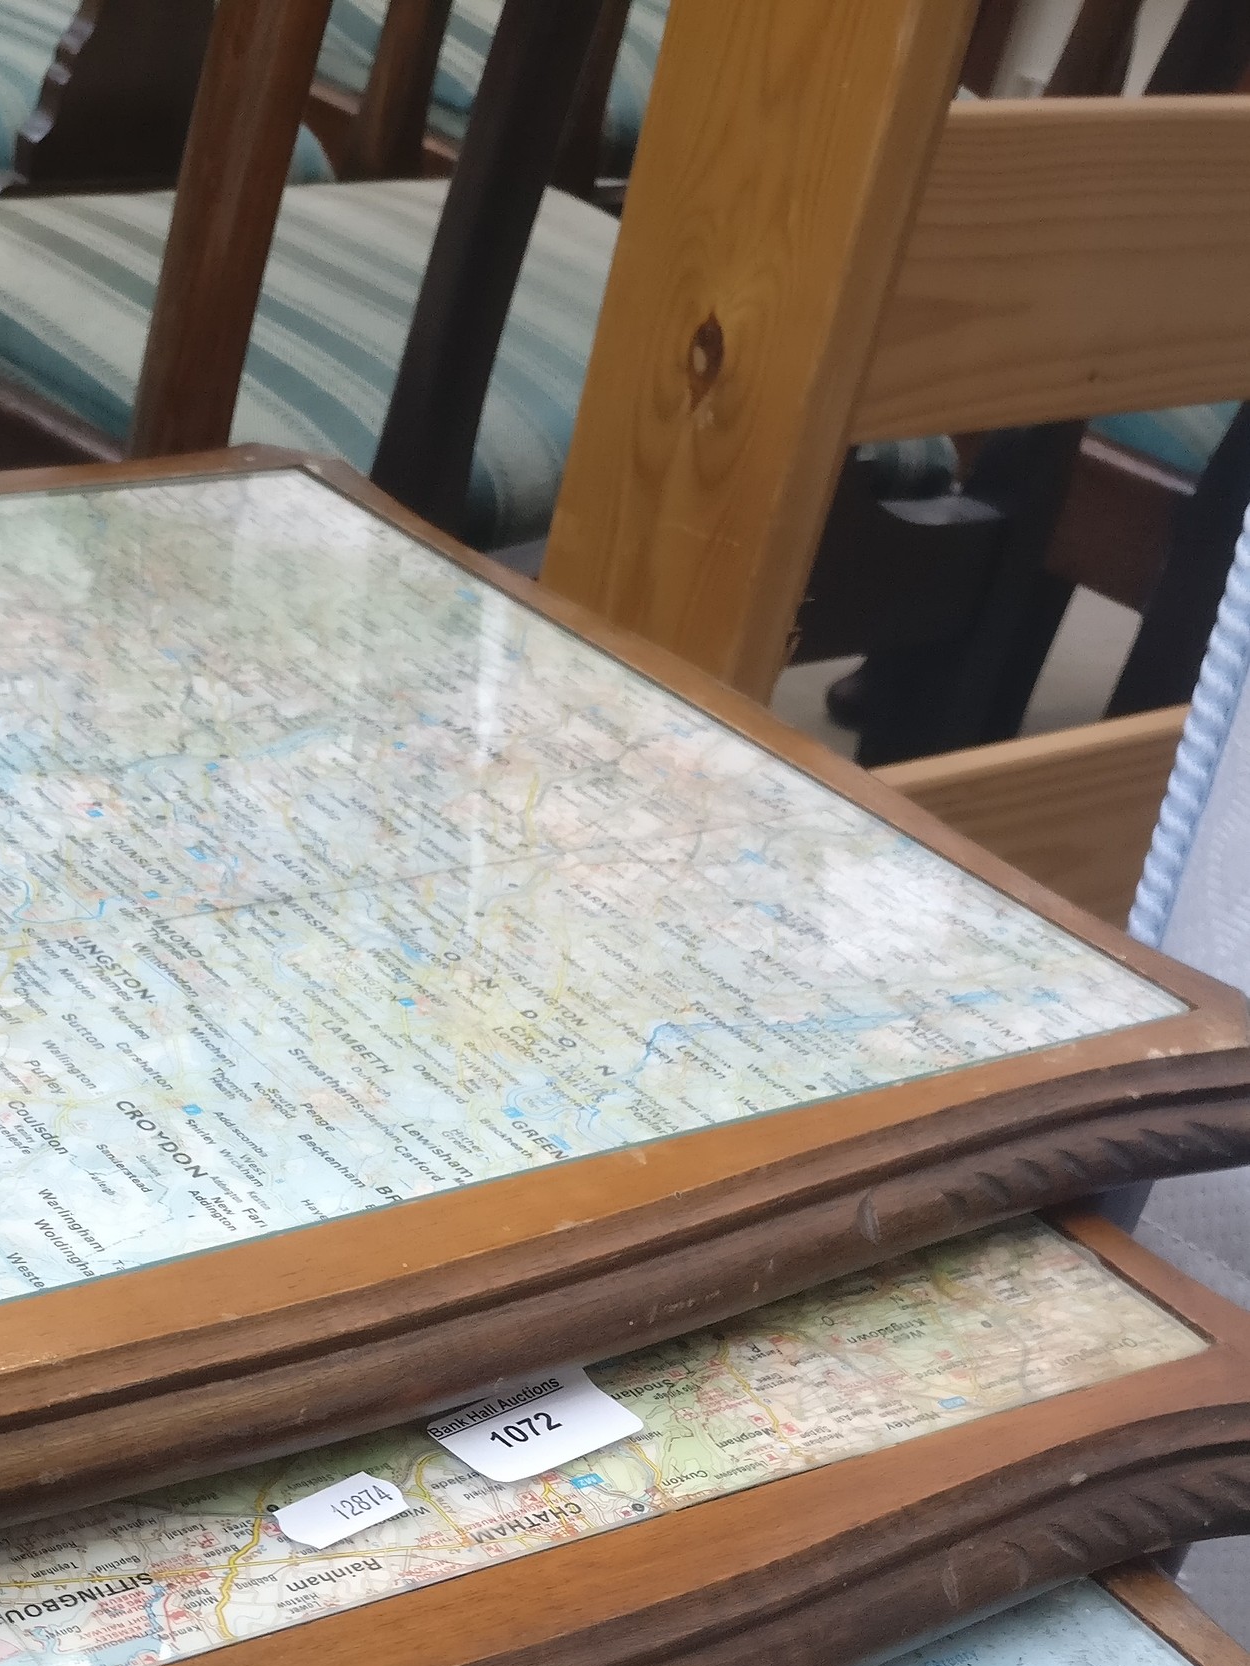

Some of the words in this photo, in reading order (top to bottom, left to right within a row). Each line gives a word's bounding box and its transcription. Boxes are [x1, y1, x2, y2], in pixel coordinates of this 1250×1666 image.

[100, 831, 175, 885] HOUNSLOW
[55, 968, 100, 1000] Malden
[129, 942, 203, 998] Wimbledon
[10, 987, 52, 1017] Cheam
[506, 971, 590, 1027] ISLINGTON
[58, 1013, 109, 1050] Sutton
[106, 1006, 154, 1040] Morden
[181, 1004, 230, 1039] Merton
[184, 1027, 241, 1068] Mitcham
[318, 1020, 395, 1074] LAMBETH
[488, 1026, 547, 1065] London
[18, 1059, 70, 1095] Purley
[35, 1039, 101, 1090] Wallington
[113, 1041, 176, 1091] Carshalton
[285, 1048, 363, 1105] Streatham
[206, 1077, 239, 1099] Heath
[209, 1068, 255, 1102] Thornton
[265, 1087, 300, 1112] South
[409, 1063, 470, 1105] Deptford
[5, 1100, 73, 1155] Coulsdon
[180, 1118, 219, 1145] Shirley
[295, 1102, 339, 1132] Penge
[112, 1099, 209, 1178] CROYDON
[399, 1123, 476, 1179] Lewisham
[477, 1117, 536, 1159] Blackheath
[93, 1143, 153, 1193] Sanderstead
[237, 1154, 268, 1175] West
[295, 1133, 369, 1189] Beckenham
[391, 1144, 445, 1182] Catford
[33, 1188, 108, 1253] Warlingham
[184, 1189, 240, 1232] Addington
[208, 1196, 236, 1215] New
[845, 1317, 925, 1346] Kingsdown
[886, 1328, 925, 1344] West
[428, 1417, 469, 1438] Bank
[469, 1404, 499, 1422] Hall
[499, 1378, 560, 1409] Auctions
[883, 1409, 939, 1432] Hartley
[490, 1412, 563, 1448] 1072
[713, 1425, 776, 1449] Meopham
[575, 1474, 598, 1487] M2
[660, 1469, 708, 1488] Cuxton
[331, 1485, 393, 1520] 12874
[164, 1522, 205, 1540] Tunstall
[221, 1519, 254, 1534] Street
[467, 1500, 583, 1543] CHATHAM
[93, 1554, 140, 1573] Bapchild
[201, 1543, 239, 1559] Borden
[29, 1559, 78, 1580] Teynham
[283, 1556, 382, 1594] Rainham
[275, 1591, 319, 1609] Halstow
[288, 1600, 321, 1614] Lower
[156, 1623, 201, 1642] Kemsley
